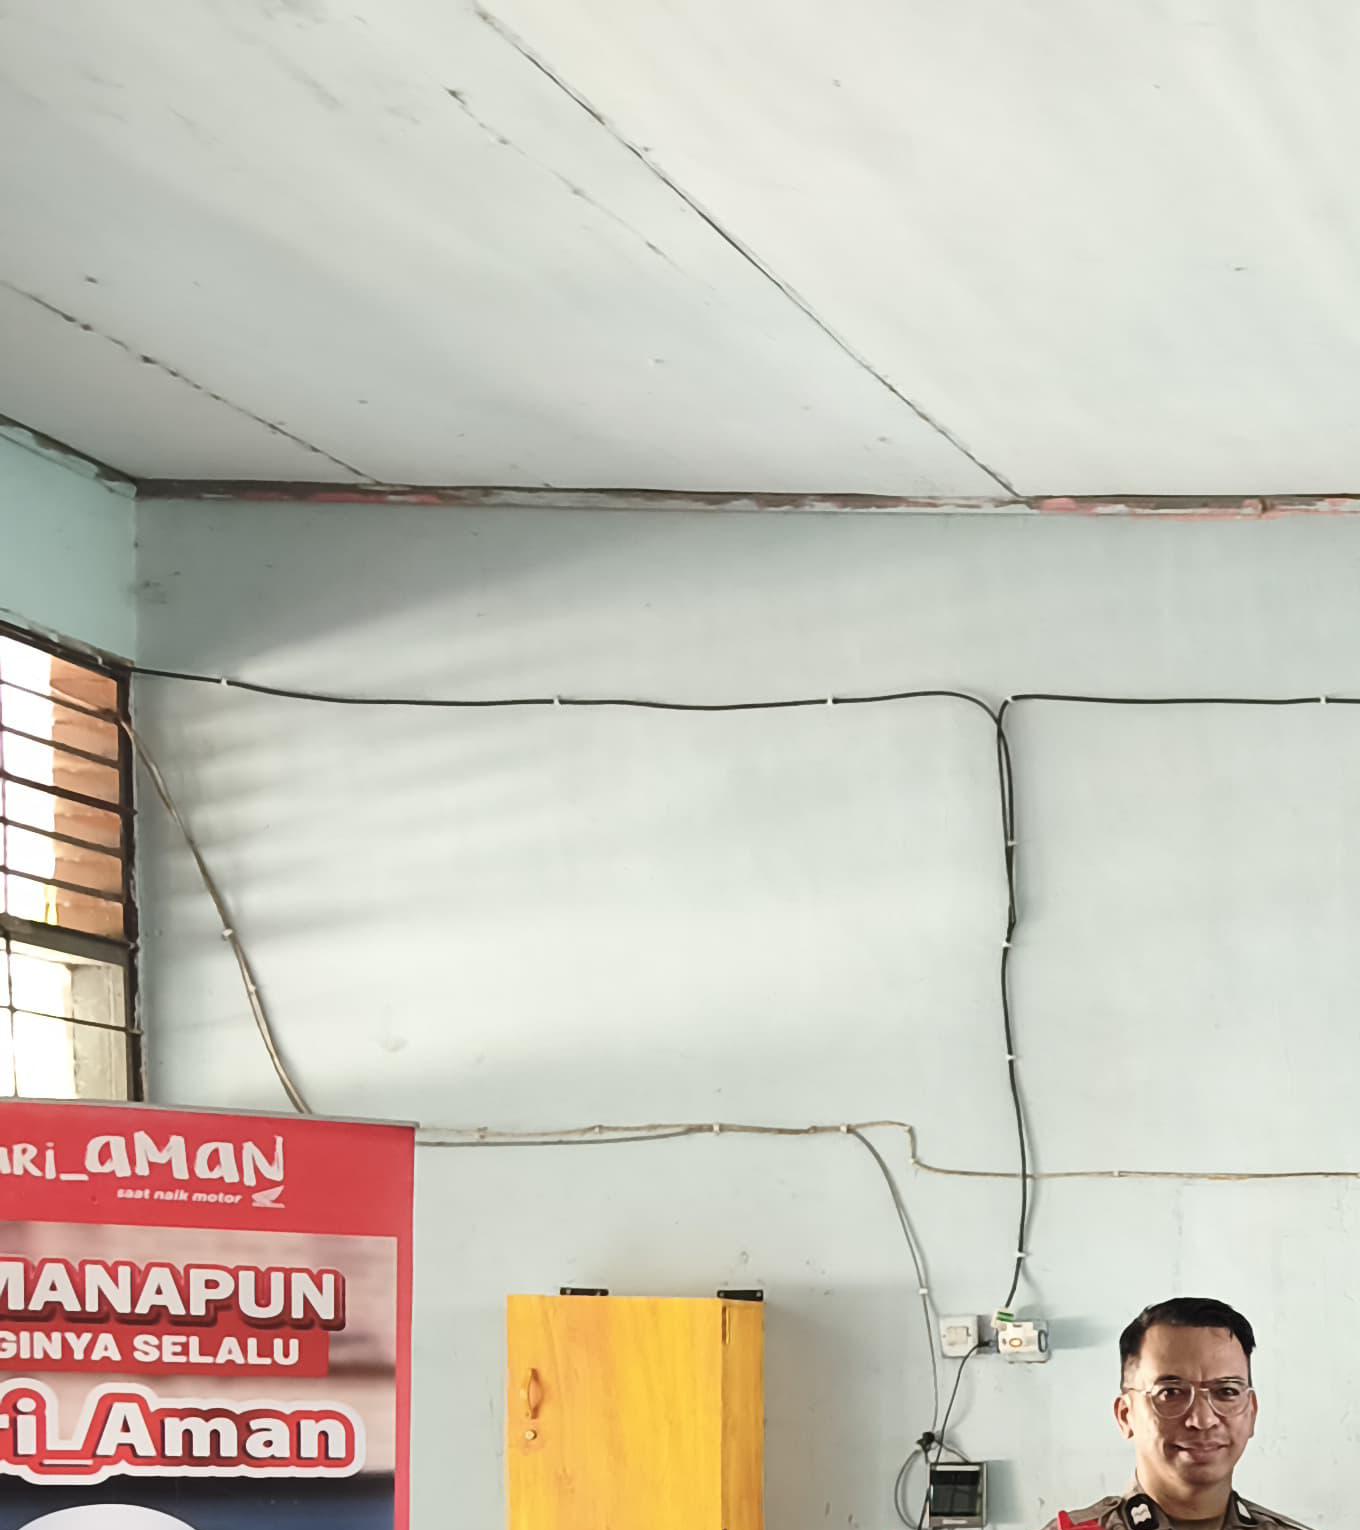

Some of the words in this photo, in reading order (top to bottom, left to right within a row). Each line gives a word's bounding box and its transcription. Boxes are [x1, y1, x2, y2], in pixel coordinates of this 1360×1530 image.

[117, 1188, 150, 1200] saat
[154, 1189, 189, 1201] naik
[192, 1191, 243, 1204] motor
[133, 1335, 299, 1365] SELALU
